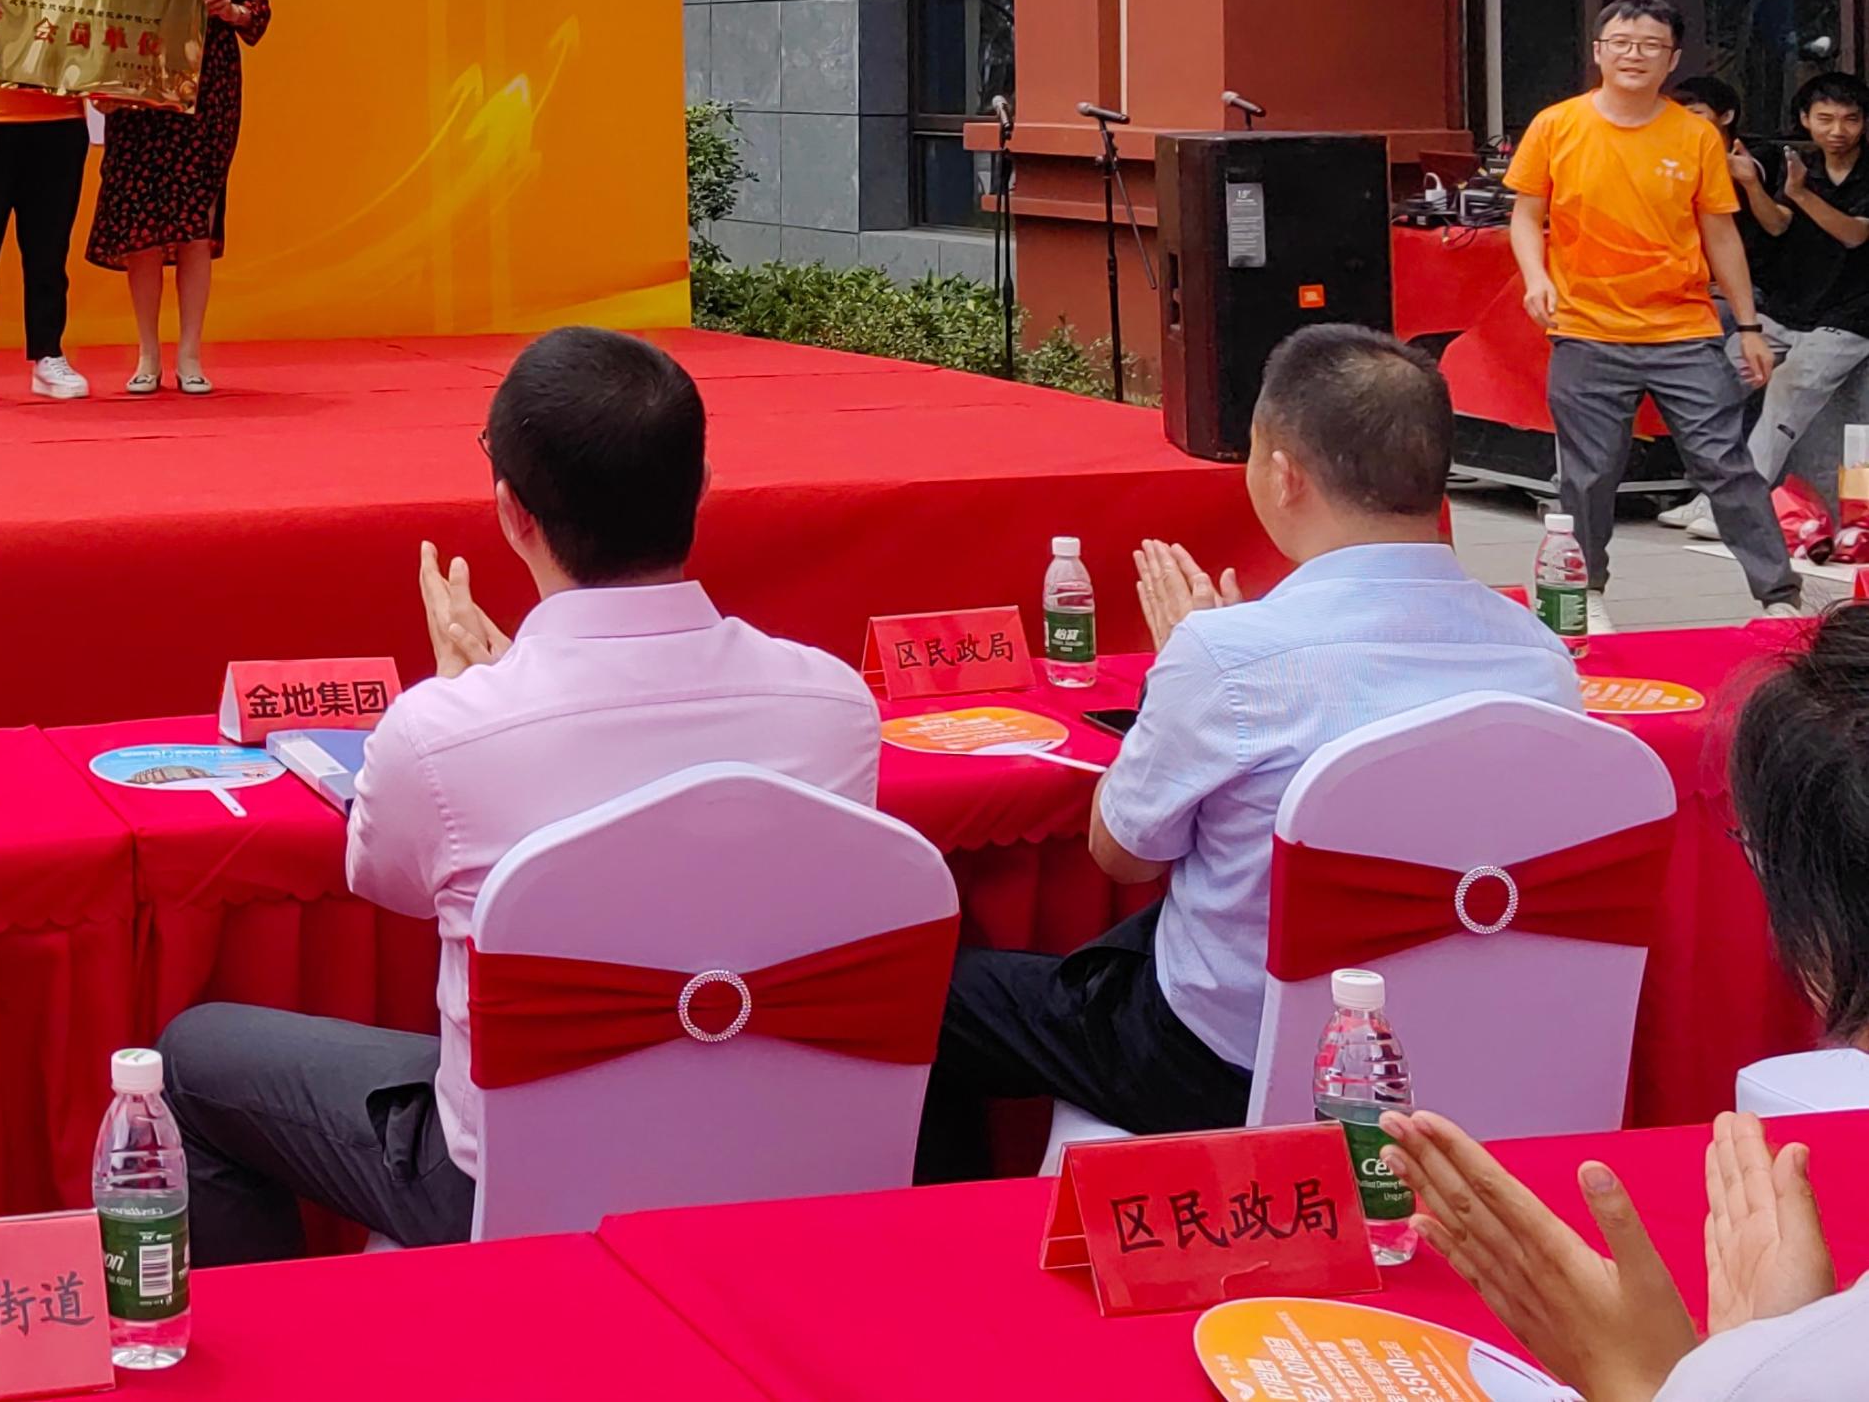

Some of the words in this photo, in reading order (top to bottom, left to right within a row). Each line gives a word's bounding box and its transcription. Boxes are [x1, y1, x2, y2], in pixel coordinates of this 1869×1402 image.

[895, 632, 1014, 669] 区民政局
[245, 681, 388, 719] 金地集团
[1110, 1178, 1338, 1254] 区民政局
